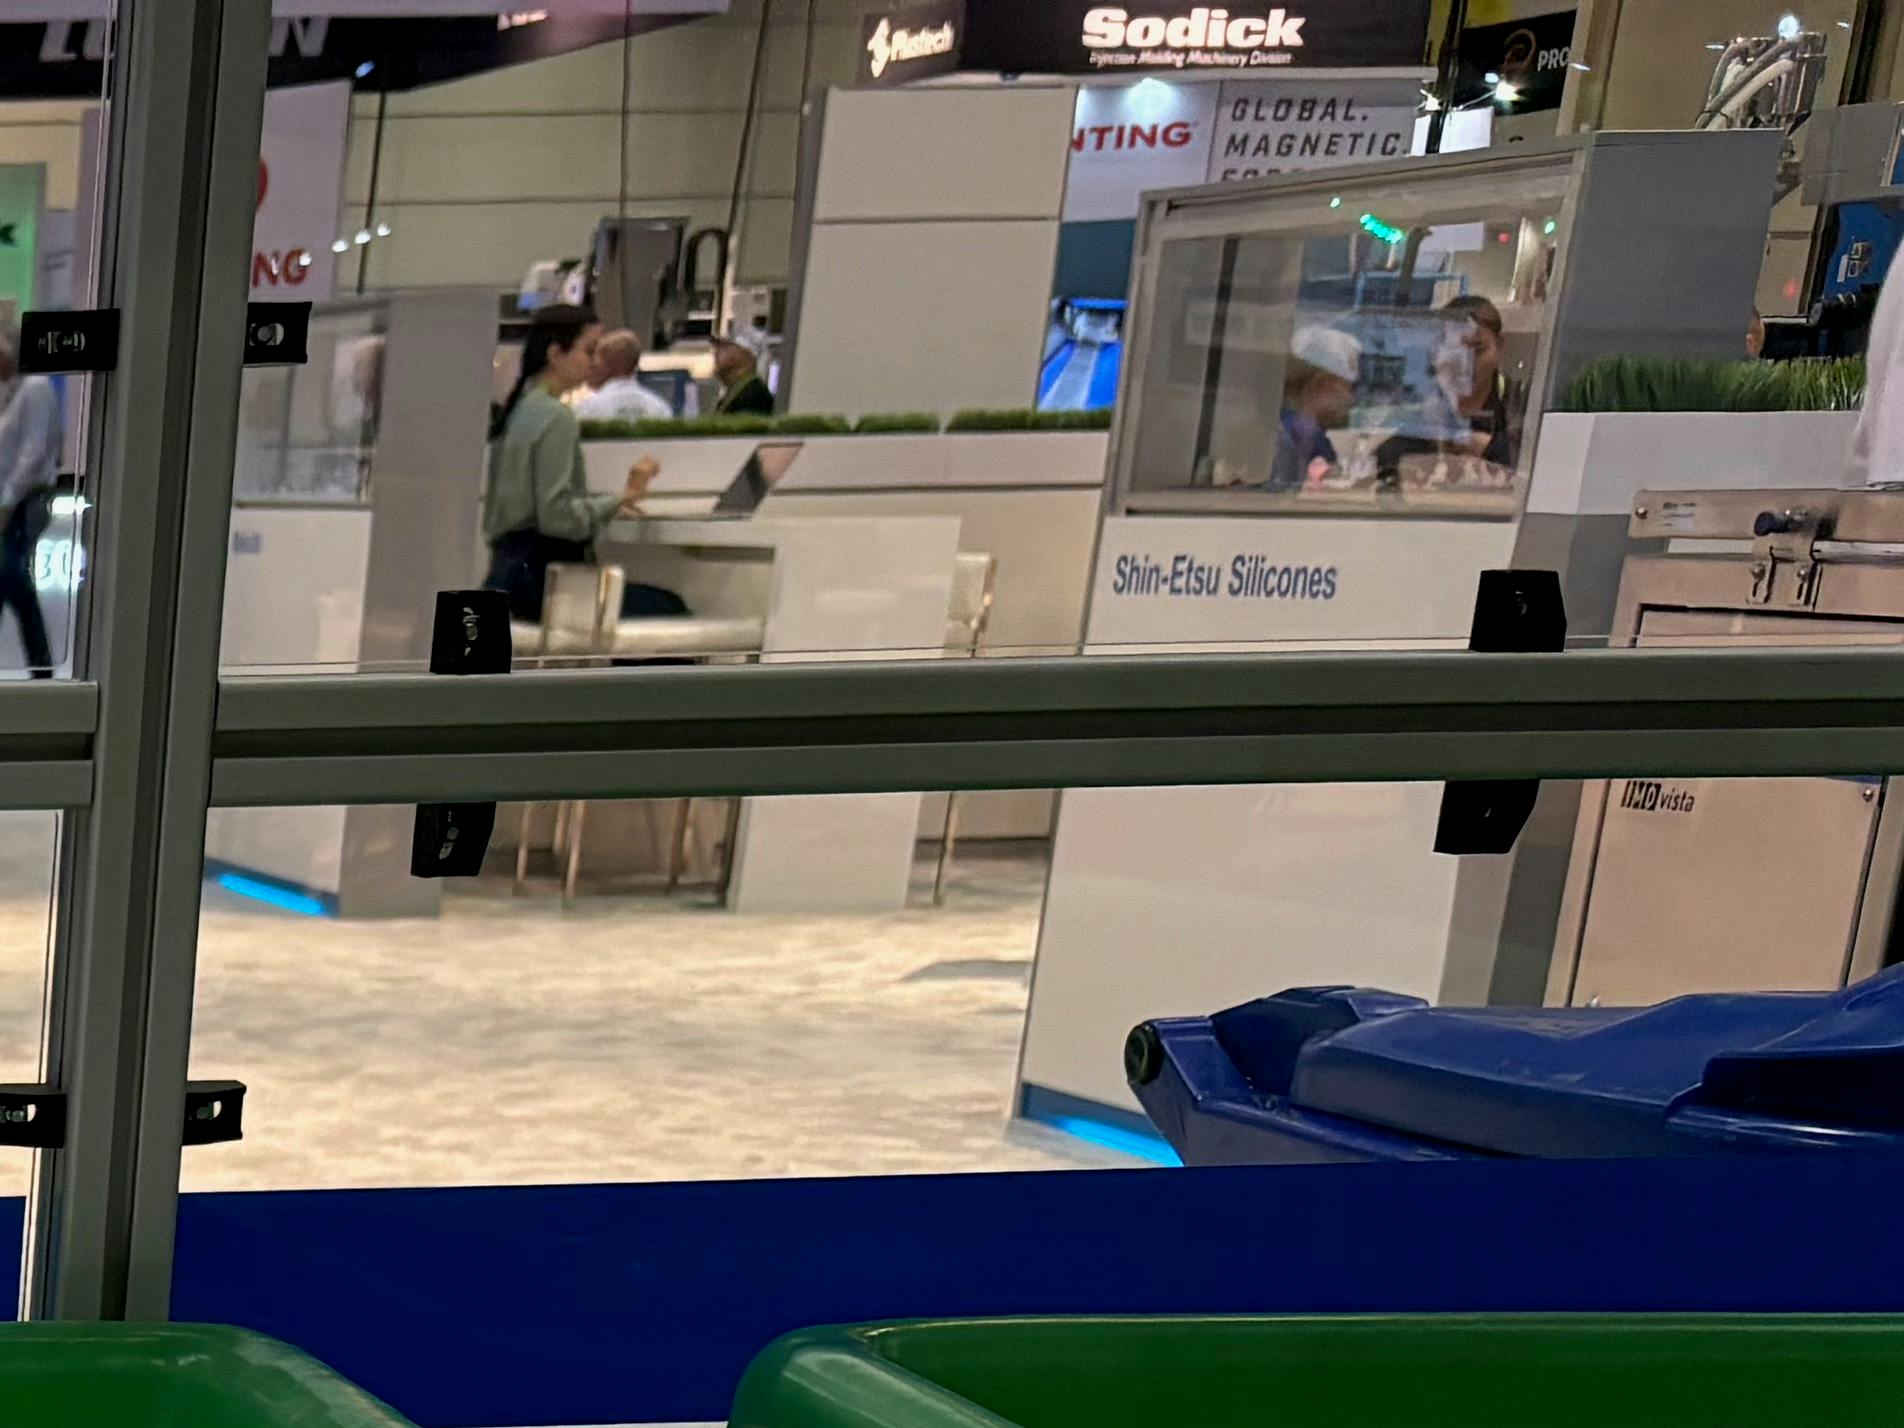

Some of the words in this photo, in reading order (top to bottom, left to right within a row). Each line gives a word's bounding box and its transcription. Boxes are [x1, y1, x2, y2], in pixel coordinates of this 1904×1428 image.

[1082, 8, 1305, 48] Sodick
[1231, 97, 1369, 122] GLOBAL.
[1224, 132, 1411, 157] MAGNETIC.
[1113, 554, 1221, 596] Shin-Etsu
[1228, 555, 1337, 599] Silicones
